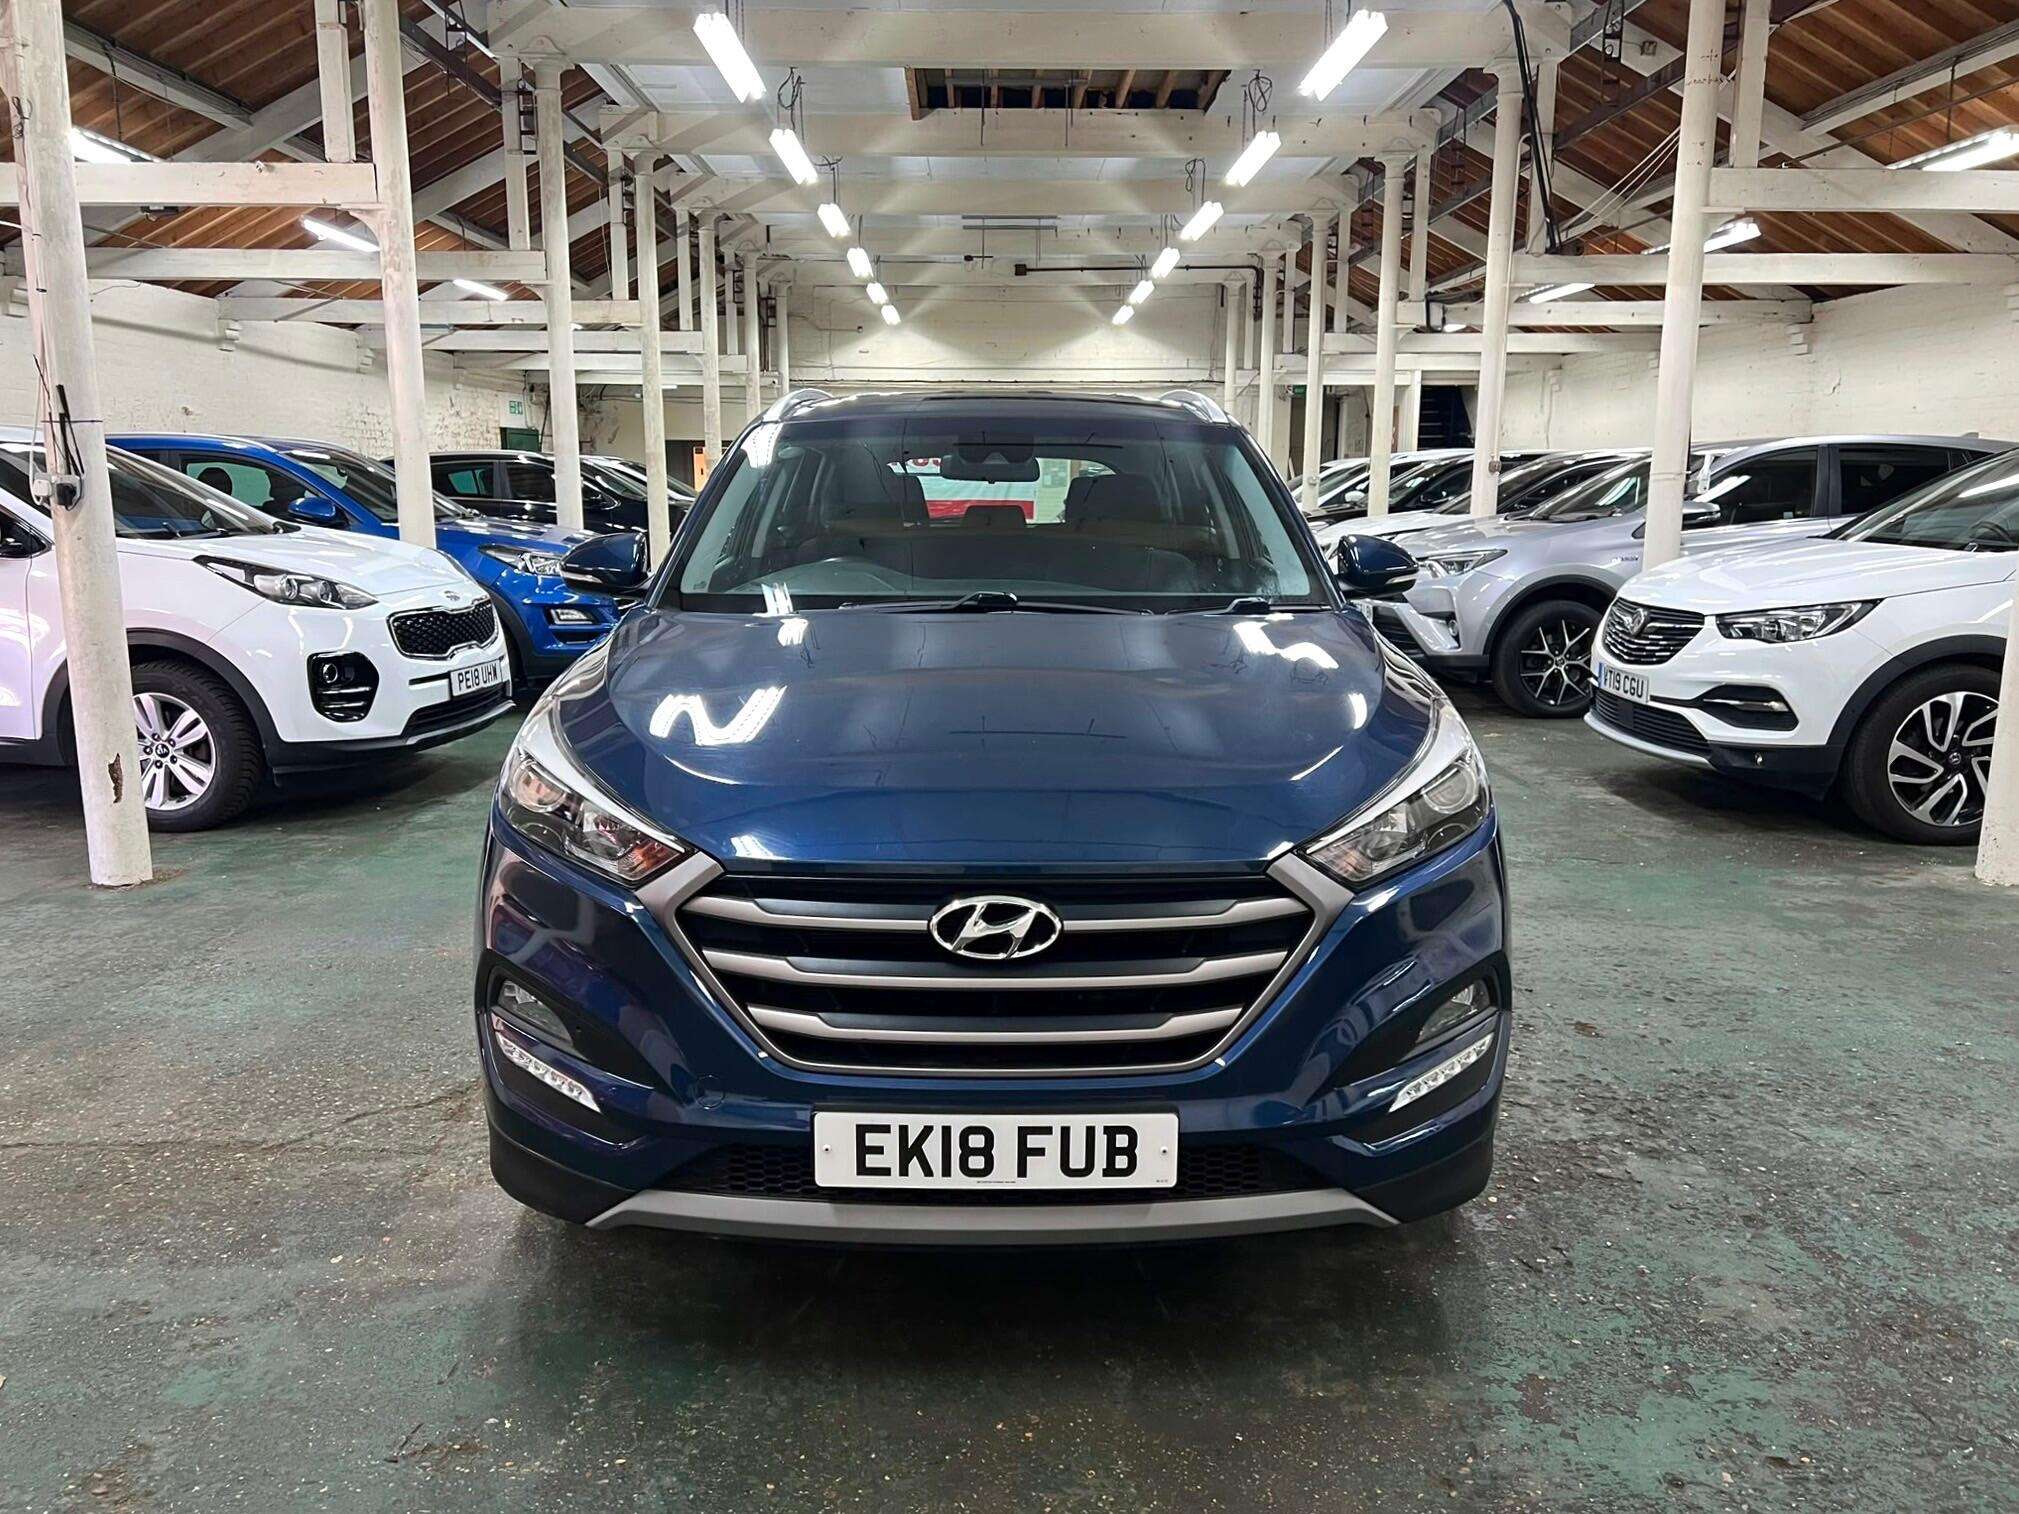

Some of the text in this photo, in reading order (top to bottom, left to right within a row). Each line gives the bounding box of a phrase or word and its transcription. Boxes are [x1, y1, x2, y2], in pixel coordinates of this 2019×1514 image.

[457, 668, 480, 692] PE18
[1623, 675, 1644, 698] CGU
[855, 1123, 1139, 1179] EK18 FUB
